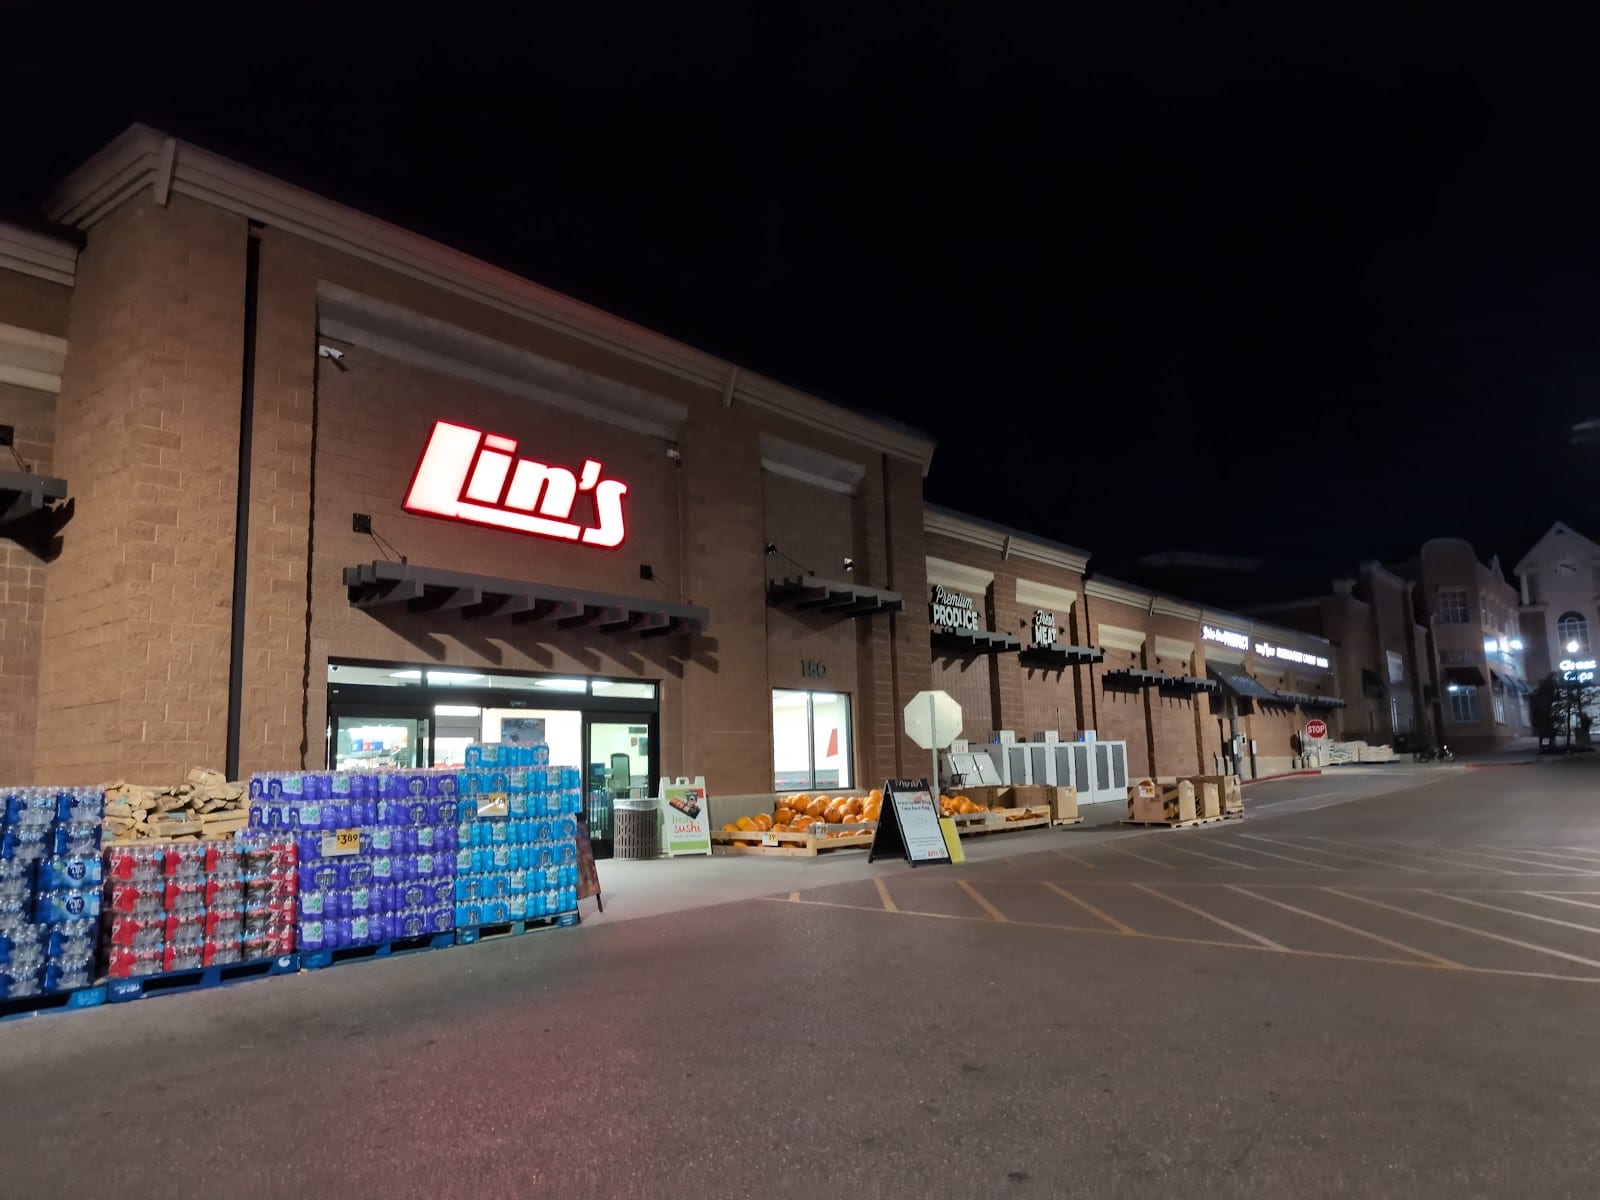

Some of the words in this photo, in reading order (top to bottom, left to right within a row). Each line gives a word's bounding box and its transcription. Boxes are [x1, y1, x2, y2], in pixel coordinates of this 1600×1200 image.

[403, 419, 629, 550] Lin's
[936, 585, 973, 609] Premium
[933, 605, 979, 631] PRODUCE
[1035, 625, 1057, 645] MEAT
[1307, 725, 1325, 734] STOP
[674, 821, 702, 833] sushi
